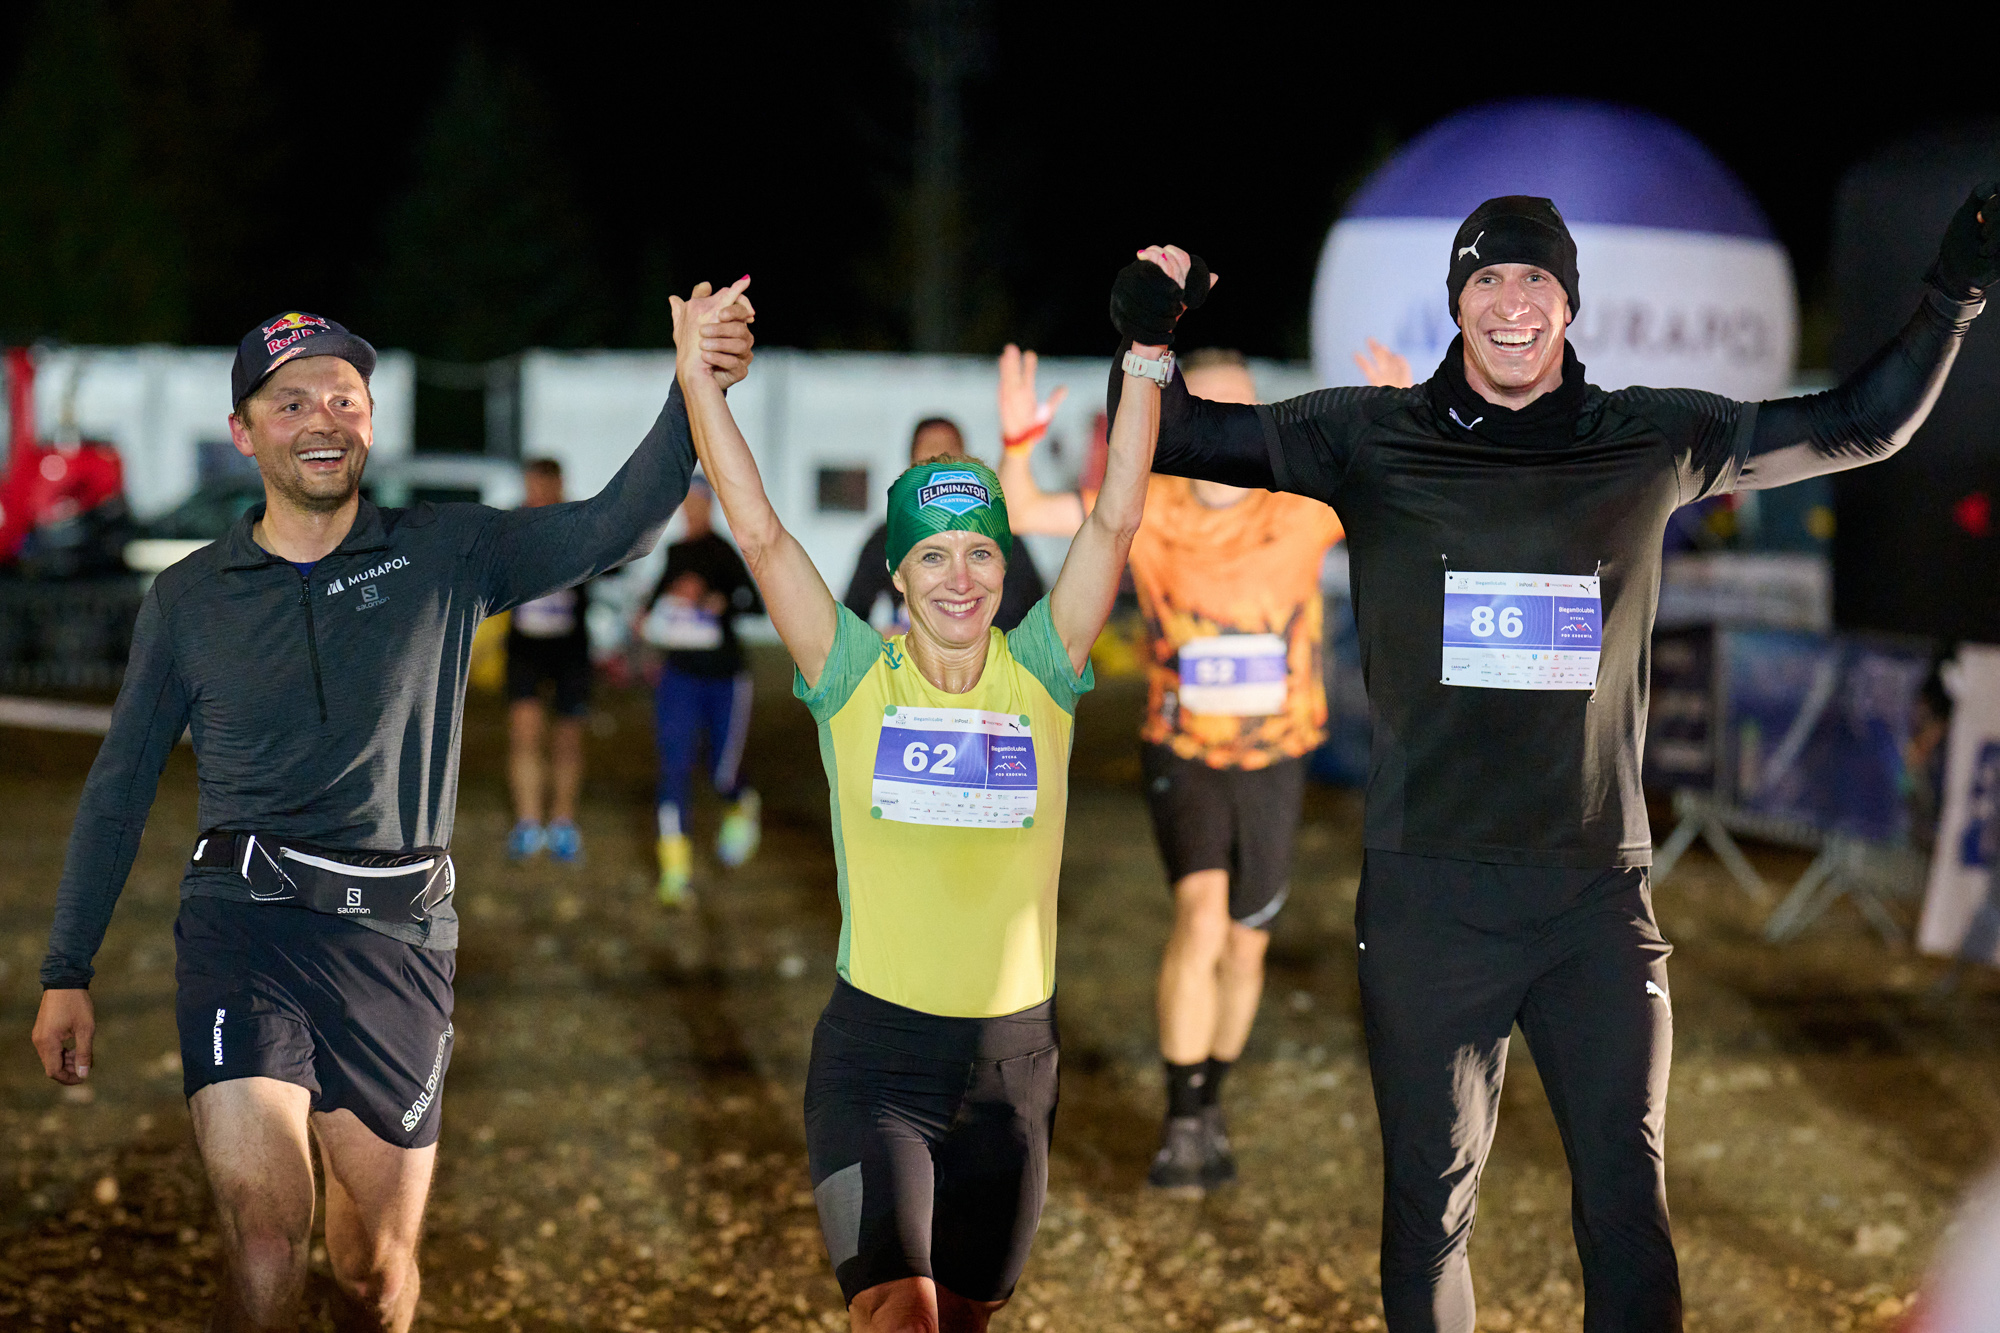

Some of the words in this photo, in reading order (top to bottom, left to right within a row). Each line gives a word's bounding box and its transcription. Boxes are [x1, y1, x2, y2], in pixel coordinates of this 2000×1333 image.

[266, 329, 301, 356] Red
[922, 484, 988, 503] ELIMINATOR
[347, 555, 411, 587] MURAPOL
[355, 595, 390, 612] salomon
[1470, 606, 1524, 638] 86
[903, 741, 957, 775] 62
[337, 907, 371, 915] salomon
